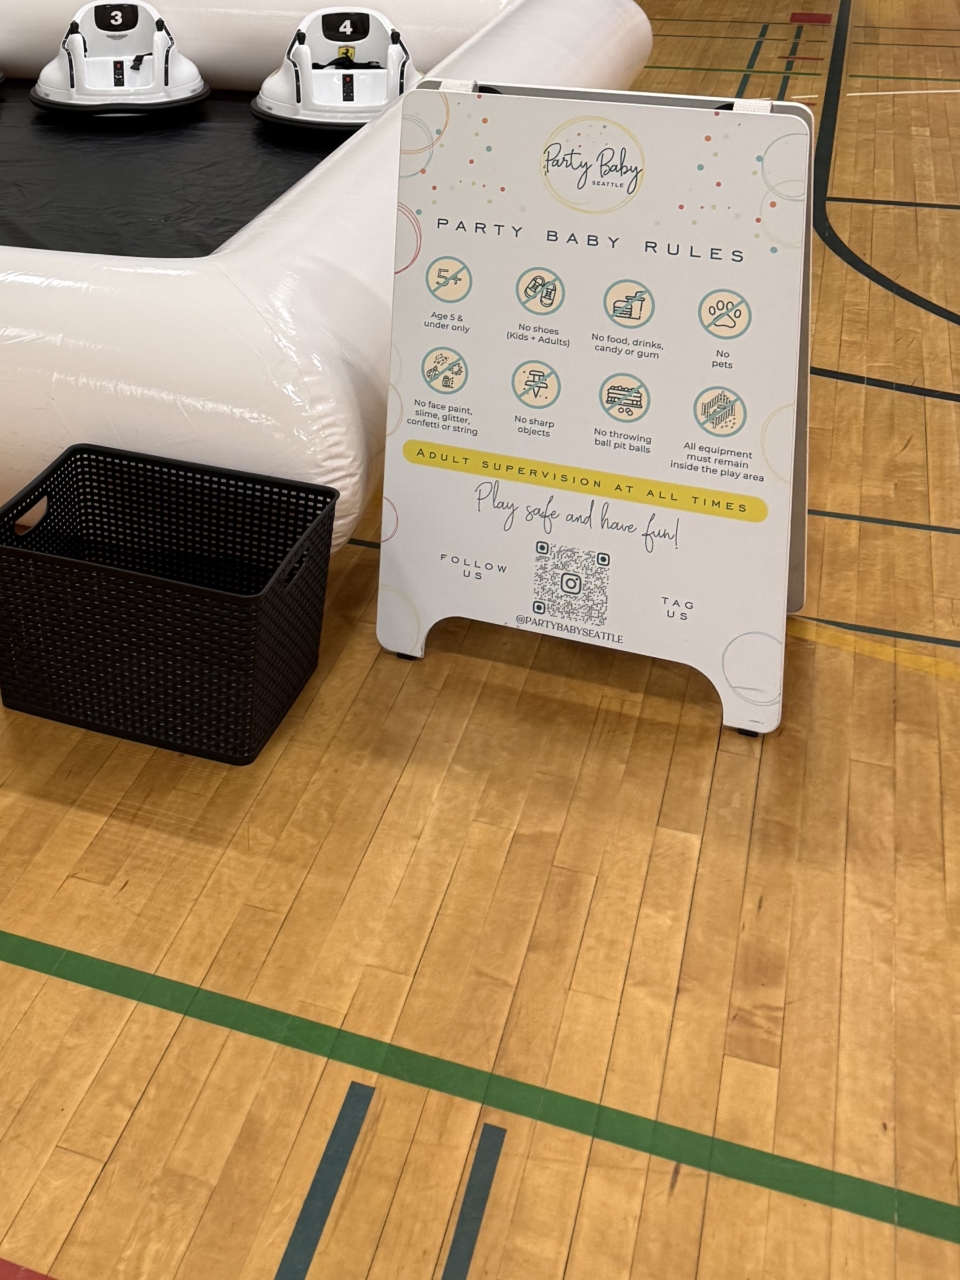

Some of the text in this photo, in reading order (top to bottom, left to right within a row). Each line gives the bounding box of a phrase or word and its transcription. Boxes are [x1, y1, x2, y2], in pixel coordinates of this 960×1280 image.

[110, 10, 123, 26] 3
[339, 19, 353, 35] 4
[543, 142, 644, 195] Party Baby
[591, 180, 624, 188] SEATTLE
[437, 218, 744, 263] PARTY BABY RULES
[431, 311, 463, 322] Age 5 &
[424, 320, 470, 333] under only
[518, 323, 559, 335] No shoes
[506, 331, 529, 341] (Kids
[538, 335, 570, 348] Adults)
[591, 333, 664, 350] No food, drinks,
[594, 344, 659, 359] candy or gum
[716, 350, 730, 358] No
[712, 360, 733, 369] pets
[414, 399, 473, 416] No face paint,
[415, 409, 471, 425] slime, glitter,
[514, 415, 555, 429] No sharp
[407, 418, 478, 437] confetti or string
[517, 426, 551, 437] objects
[594, 428, 652, 445] No throwing
[594, 438, 651, 454] ball pit balls
[684, 441, 753, 460] All equipment
[686, 453, 749, 469] must remain
[670, 460, 765, 483] inside the play area
[416, 448, 747, 513] ADULT SUPERVISION AT ALL TIMES
[475, 480, 680, 554] Play safe and have fun!
[440, 554, 507, 573] FOLLOW
[463, 570, 483, 580] US
[661, 596, 694, 610] TAG
[667, 609, 688, 621] US
[515, 614, 624, 644] @PARTYBABYSEATTLE
